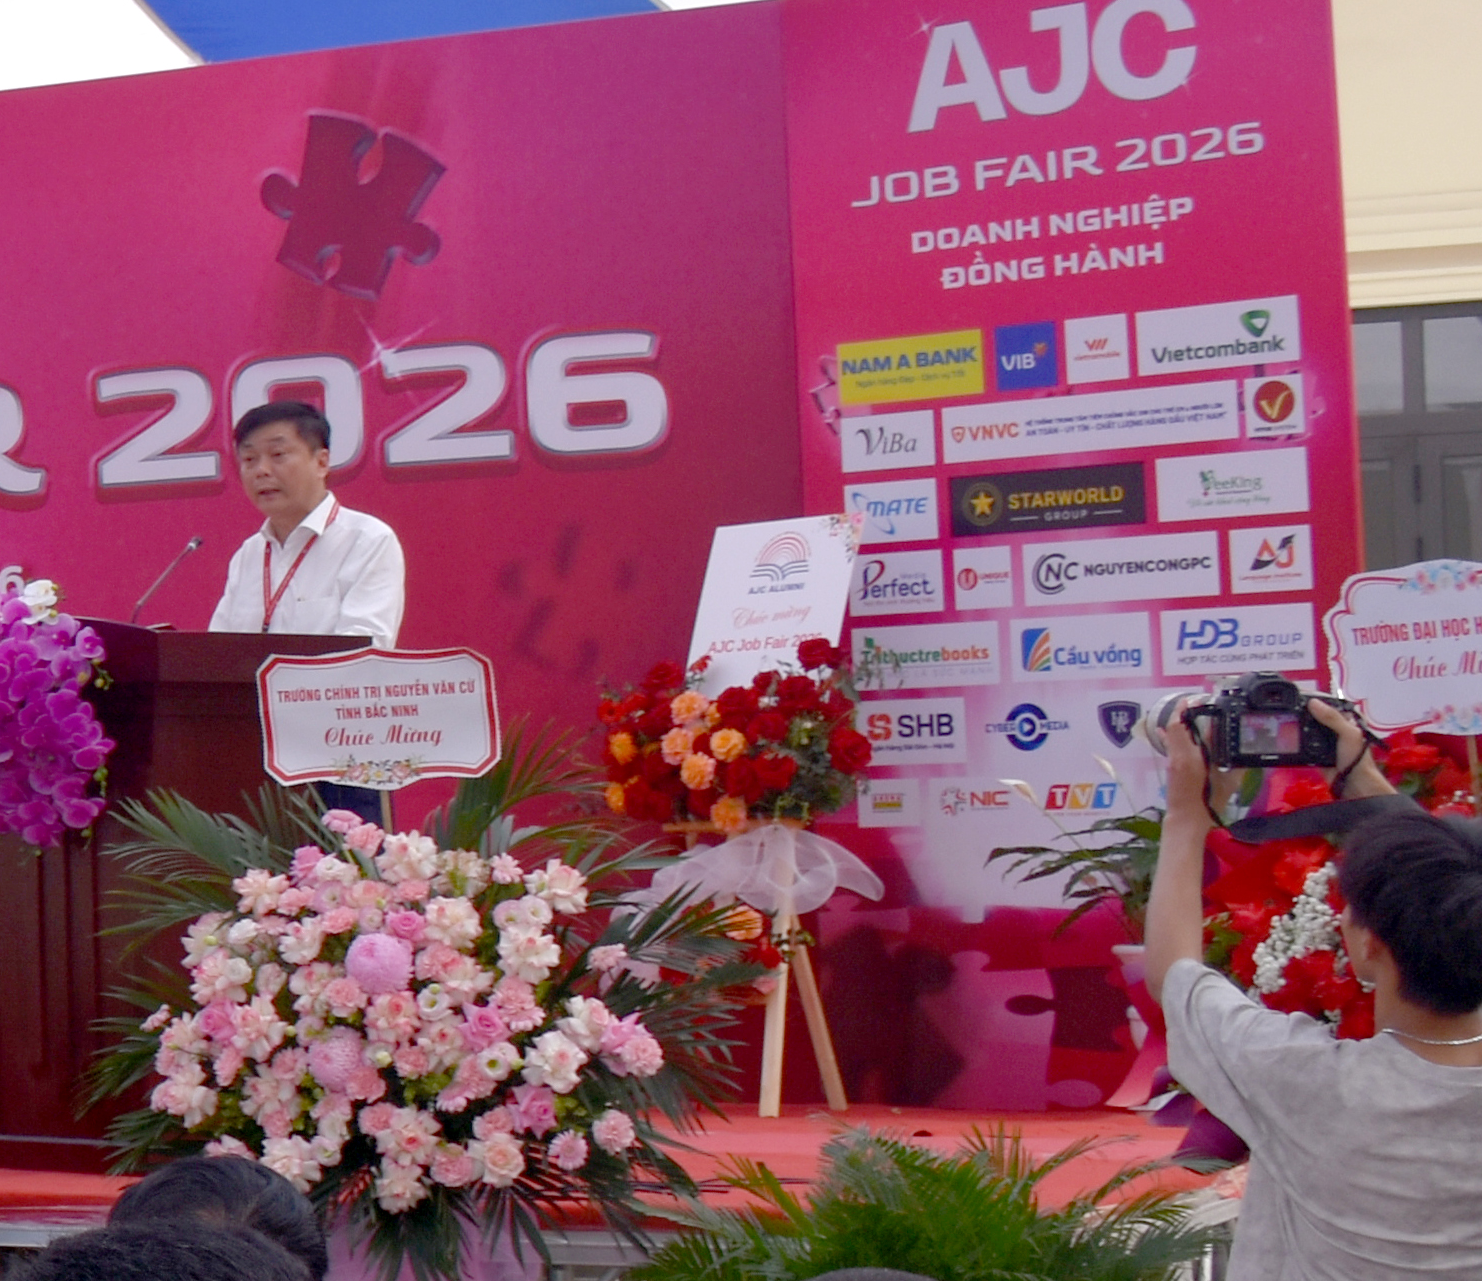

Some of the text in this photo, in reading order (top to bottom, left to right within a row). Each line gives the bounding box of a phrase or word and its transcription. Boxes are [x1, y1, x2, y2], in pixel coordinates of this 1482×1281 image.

[851, 121, 1264, 207] JOB FAIR 2026
[911, 194, 1194, 254] DOANH NGHIỆP
[940, 242, 1164, 290] ĐỒNG HÀNH
[841, 346, 977, 375] NAM A BANK
[1001, 353, 1036, 371] VIB
[1151, 335, 1285, 363] Vietcombank
[97, 330, 669, 488] 2026
[969, 423, 1019, 441] VNVC
[1008, 485, 1125, 511] STARWORLD
[1044, 510, 1088, 522] GROUP
[1084, 556, 1211, 577] NGUYENCONGPC
[748, 582, 805, 595] AJC ALUMNI
[857, 560, 934, 600] Perfect
[708, 639, 735, 654] AJC
[736, 637, 761, 652] Job
[764, 635, 789, 650] Fair
[1177, 618, 1303, 651] HDB GROUP
[1352, 618, 1471, 646] TRƯỜNG ĐẠI HỌC
[1393, 655, 1447, 681] Chúc
[278, 686, 321, 703] TRƯỜNG
[325, 685, 360, 700] CHÍNH
[364, 685, 382, 701] TRỊ
[385, 679, 429, 697] NGUYỄN
[433, 680, 455, 695] VĂN
[336, 703, 419, 720] TỈNH BẮC NINH
[324, 724, 443, 747] Chúc Mừng
[897, 713, 954, 738] SHB
[1040, 721, 1069, 731] MEDIA
[1045, 782, 1117, 809] TVT
